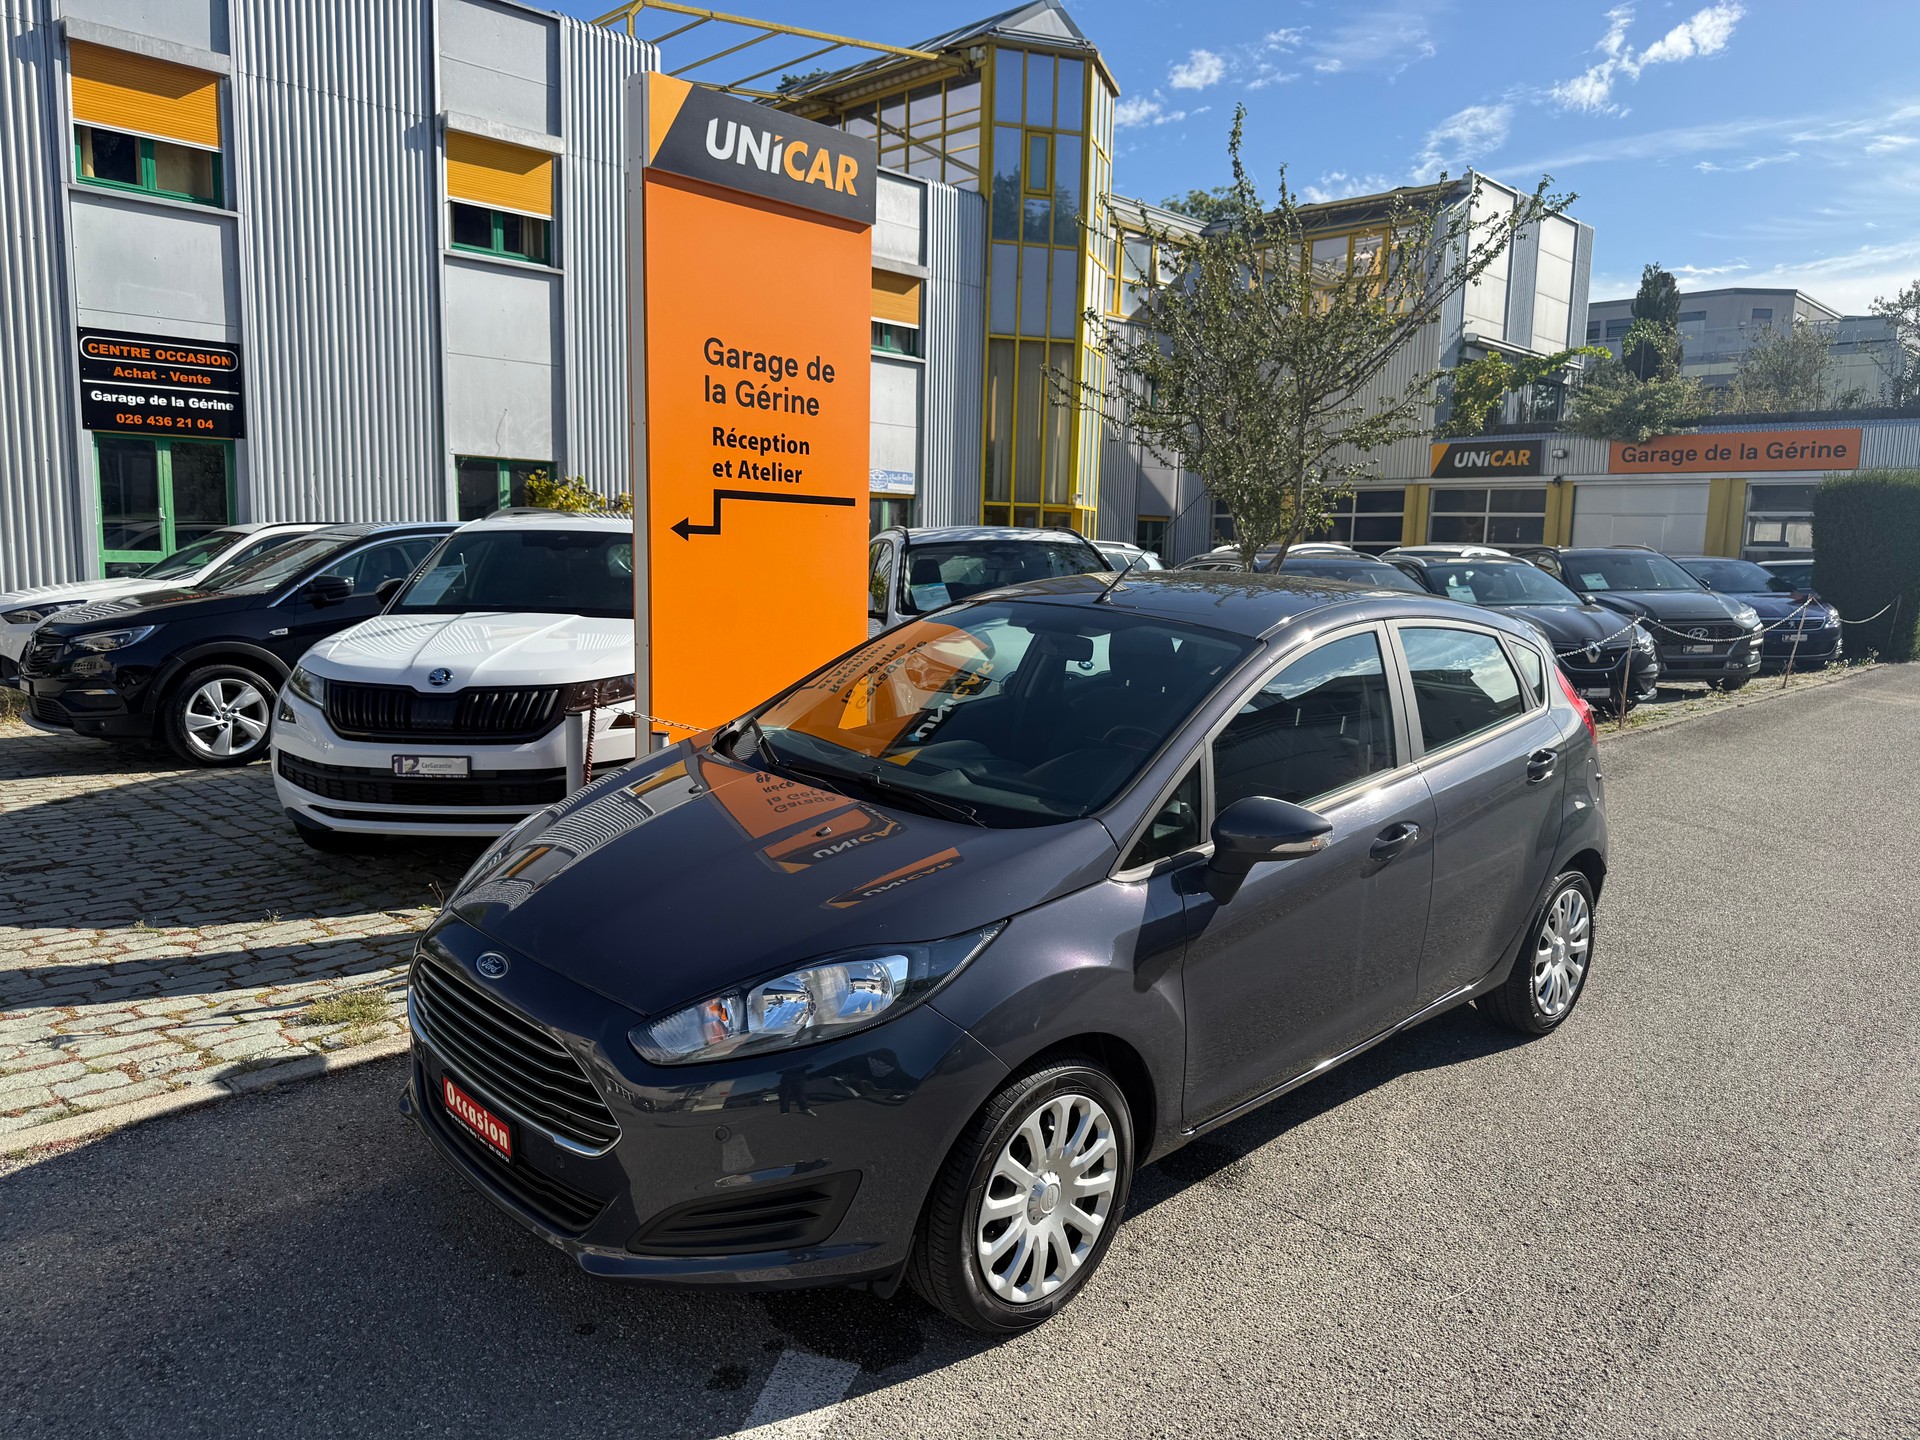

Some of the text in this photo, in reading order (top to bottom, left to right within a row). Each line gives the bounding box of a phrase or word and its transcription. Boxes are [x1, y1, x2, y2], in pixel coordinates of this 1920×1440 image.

[87, 342, 232, 367] CENTRE OCCASION
[703, 337, 836, 384] Garage de
[113, 366, 157, 380] Achat
[169, 371, 212, 385] Vente
[90, 389, 235, 411] Garage de la Gérine
[704, 374, 820, 417] la Gérine
[116, 413, 214, 430] 026 436 21 04
[712, 426, 810, 456] Réception
[1621, 440, 1847, 466] Garage de la Gérine
[712, 459, 803, 484] et Atelier
[446, 1080, 508, 1150] Occasion
